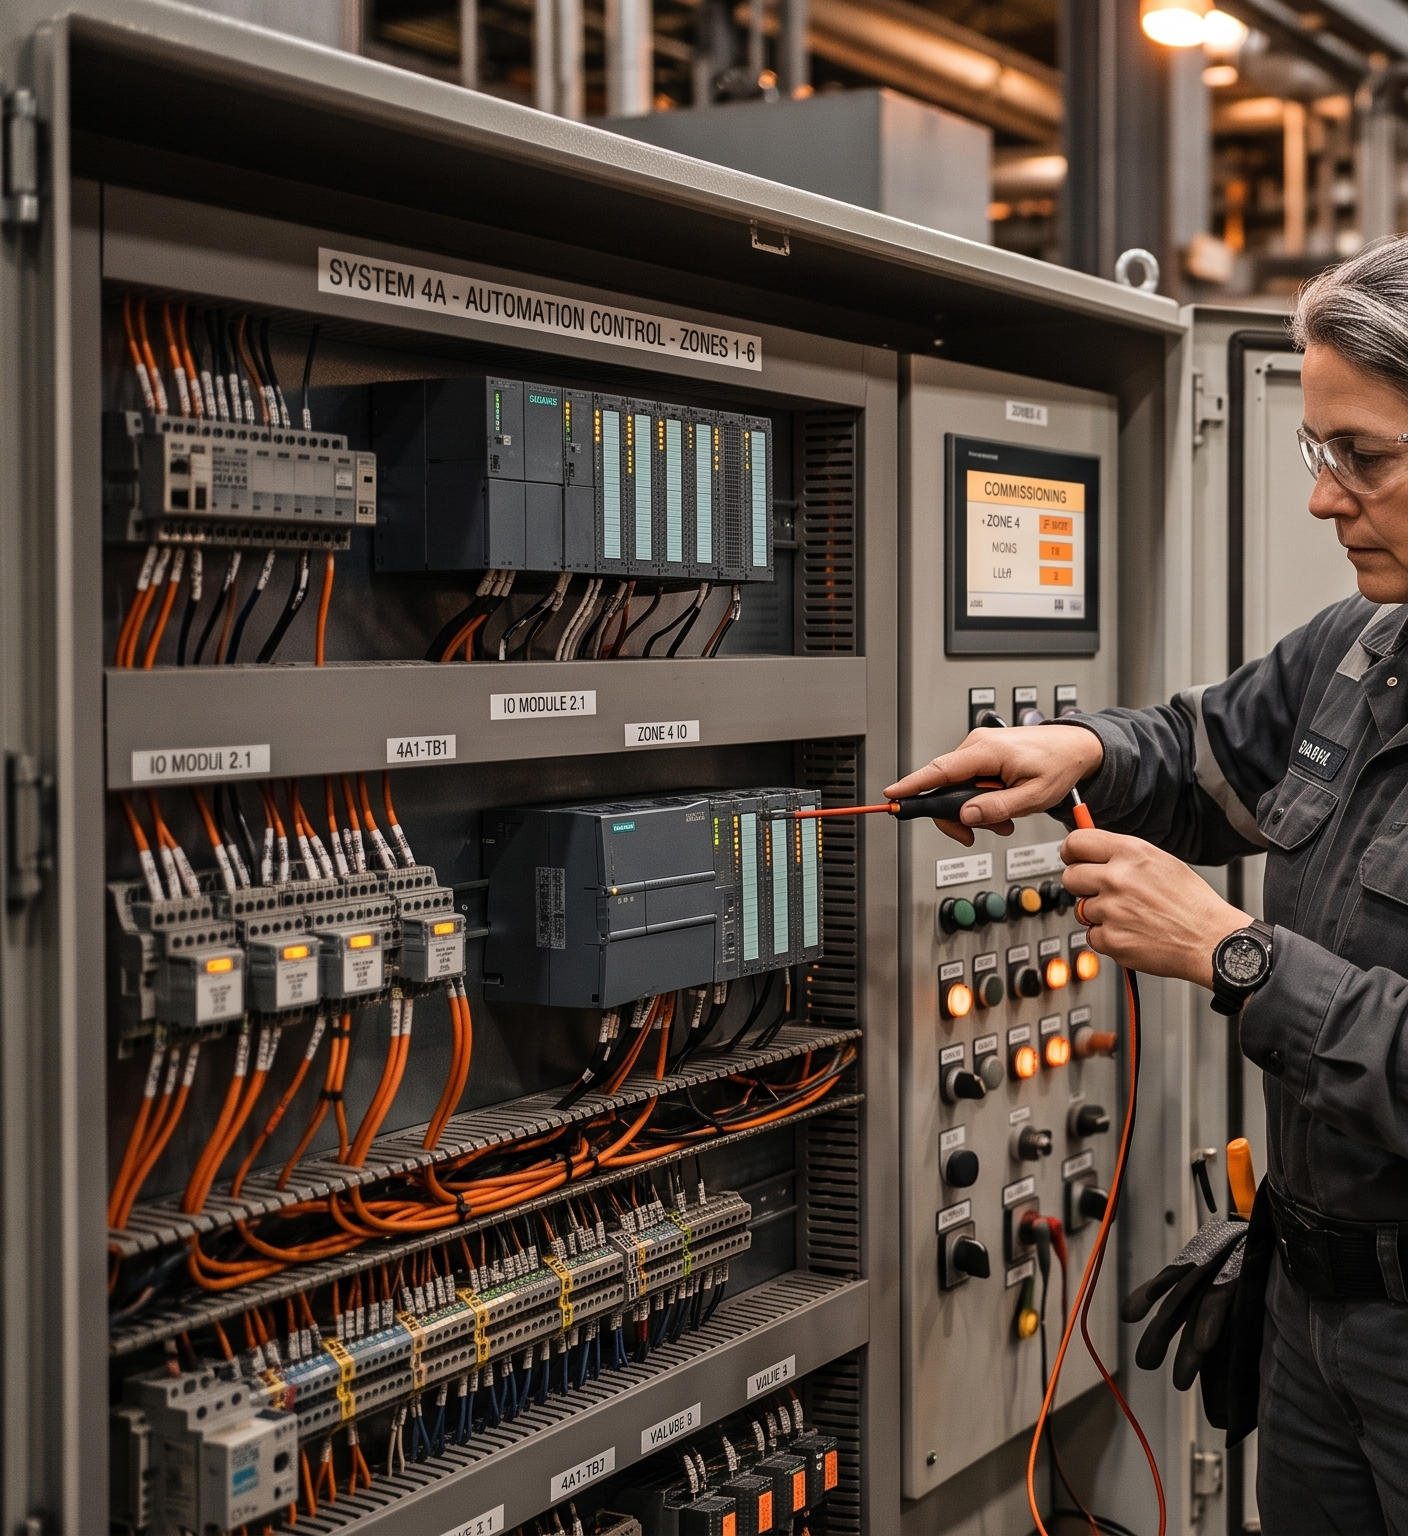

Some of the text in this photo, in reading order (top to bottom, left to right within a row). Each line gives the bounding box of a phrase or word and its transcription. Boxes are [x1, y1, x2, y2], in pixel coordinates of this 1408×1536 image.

[329, 258, 415, 300] SYSTEM
[421, 277, 447, 306] 4A
[465, 286, 585, 331] AUTOMATION
[590, 310, 666, 346] CONTROL
[680, 327, 728, 358] ZONES
[733, 339, 756, 363] 1-6
[984, 481, 1067, 504] COMMISSIONING
[986, 514, 1020, 529] ZONE 4
[504, 695, 586, 714] IO MODULE 2.1
[637, 724, 687, 741] ZONE 4 IO
[396, 739, 448, 759] 4A1-TB1
[150, 755, 167, 774] IO
[229, 751, 251, 770] 2.1
